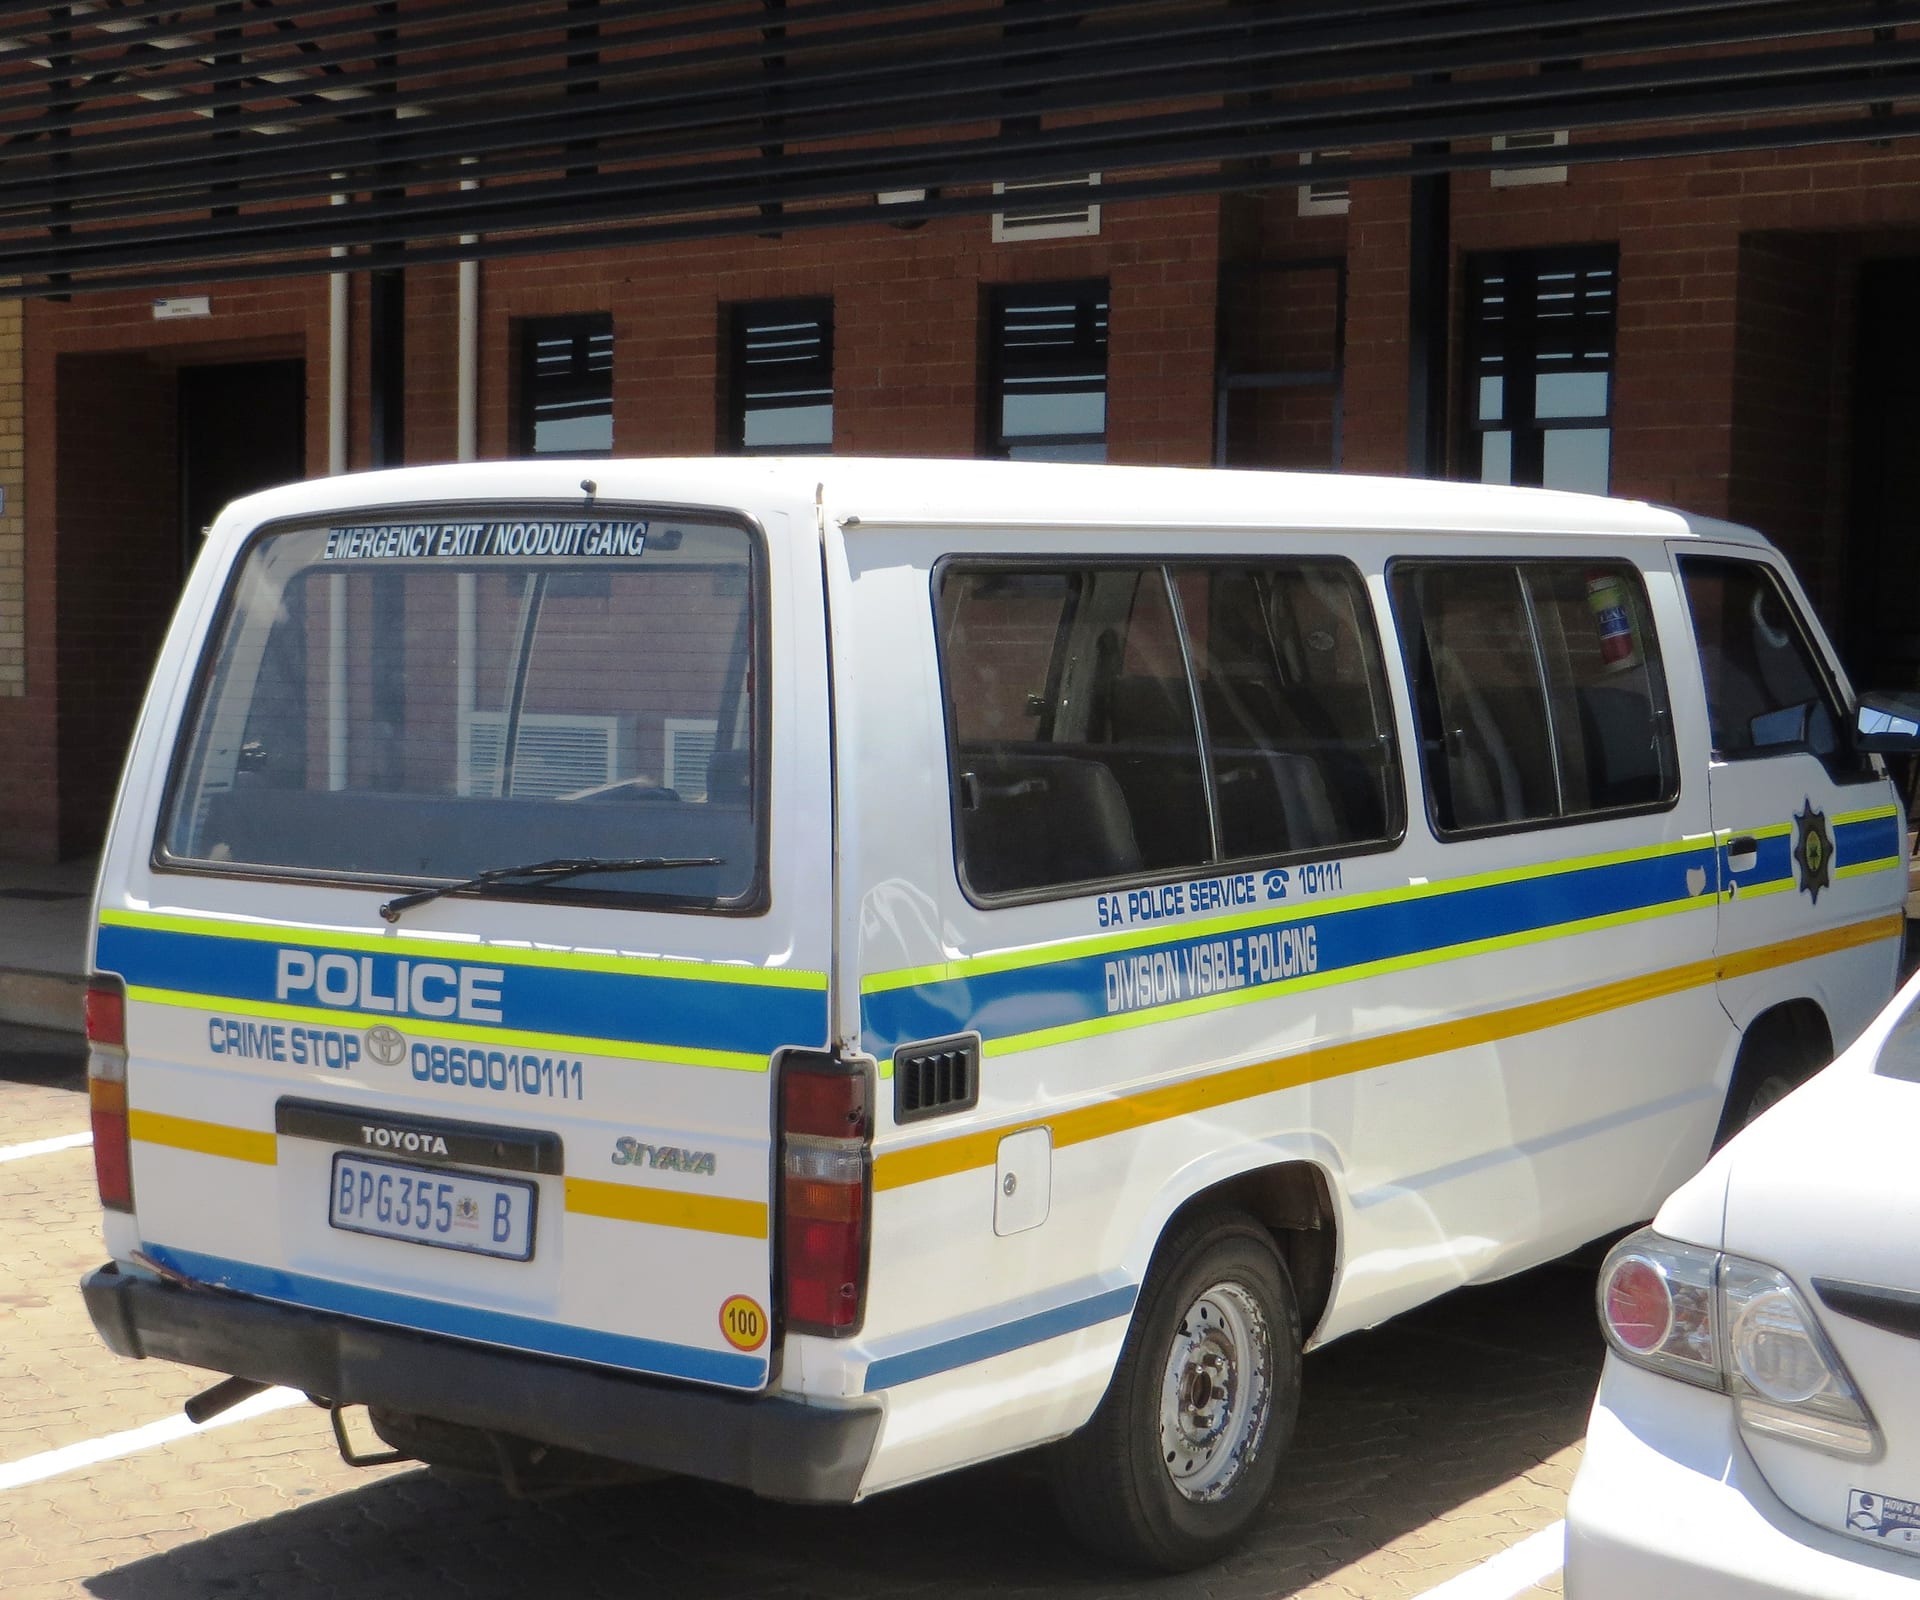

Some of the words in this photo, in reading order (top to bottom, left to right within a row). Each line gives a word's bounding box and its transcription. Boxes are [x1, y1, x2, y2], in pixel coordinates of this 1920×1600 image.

[323, 526, 439, 559] EMERGENCY
[437, 523, 484, 556] EXIT
[481, 524, 495, 555] /
[493, 522, 646, 556] NOODUITGANG
[1097, 895, 1123, 927] SA
[1127, 885, 1185, 923] POLICE
[1188, 874, 1257, 912] SERVICE
[1298, 862, 1343, 895] 10111
[276, 948, 505, 1023] POLICE
[1104, 949, 1181, 1012] DIVISION
[1183, 937, 1245, 997] VISIBLE
[1248, 924, 1318, 984] POLICING
[208, 1016, 288, 1062] CRIME
[290, 1027, 361, 1070] STOP
[411, 1042, 584, 1100] 0860010111
[361, 1125, 449, 1155] TOYOTA
[339, 1166, 454, 1233] BPG355
[492, 1191, 512, 1243] B
[728, 1306, 757, 1337] 100
